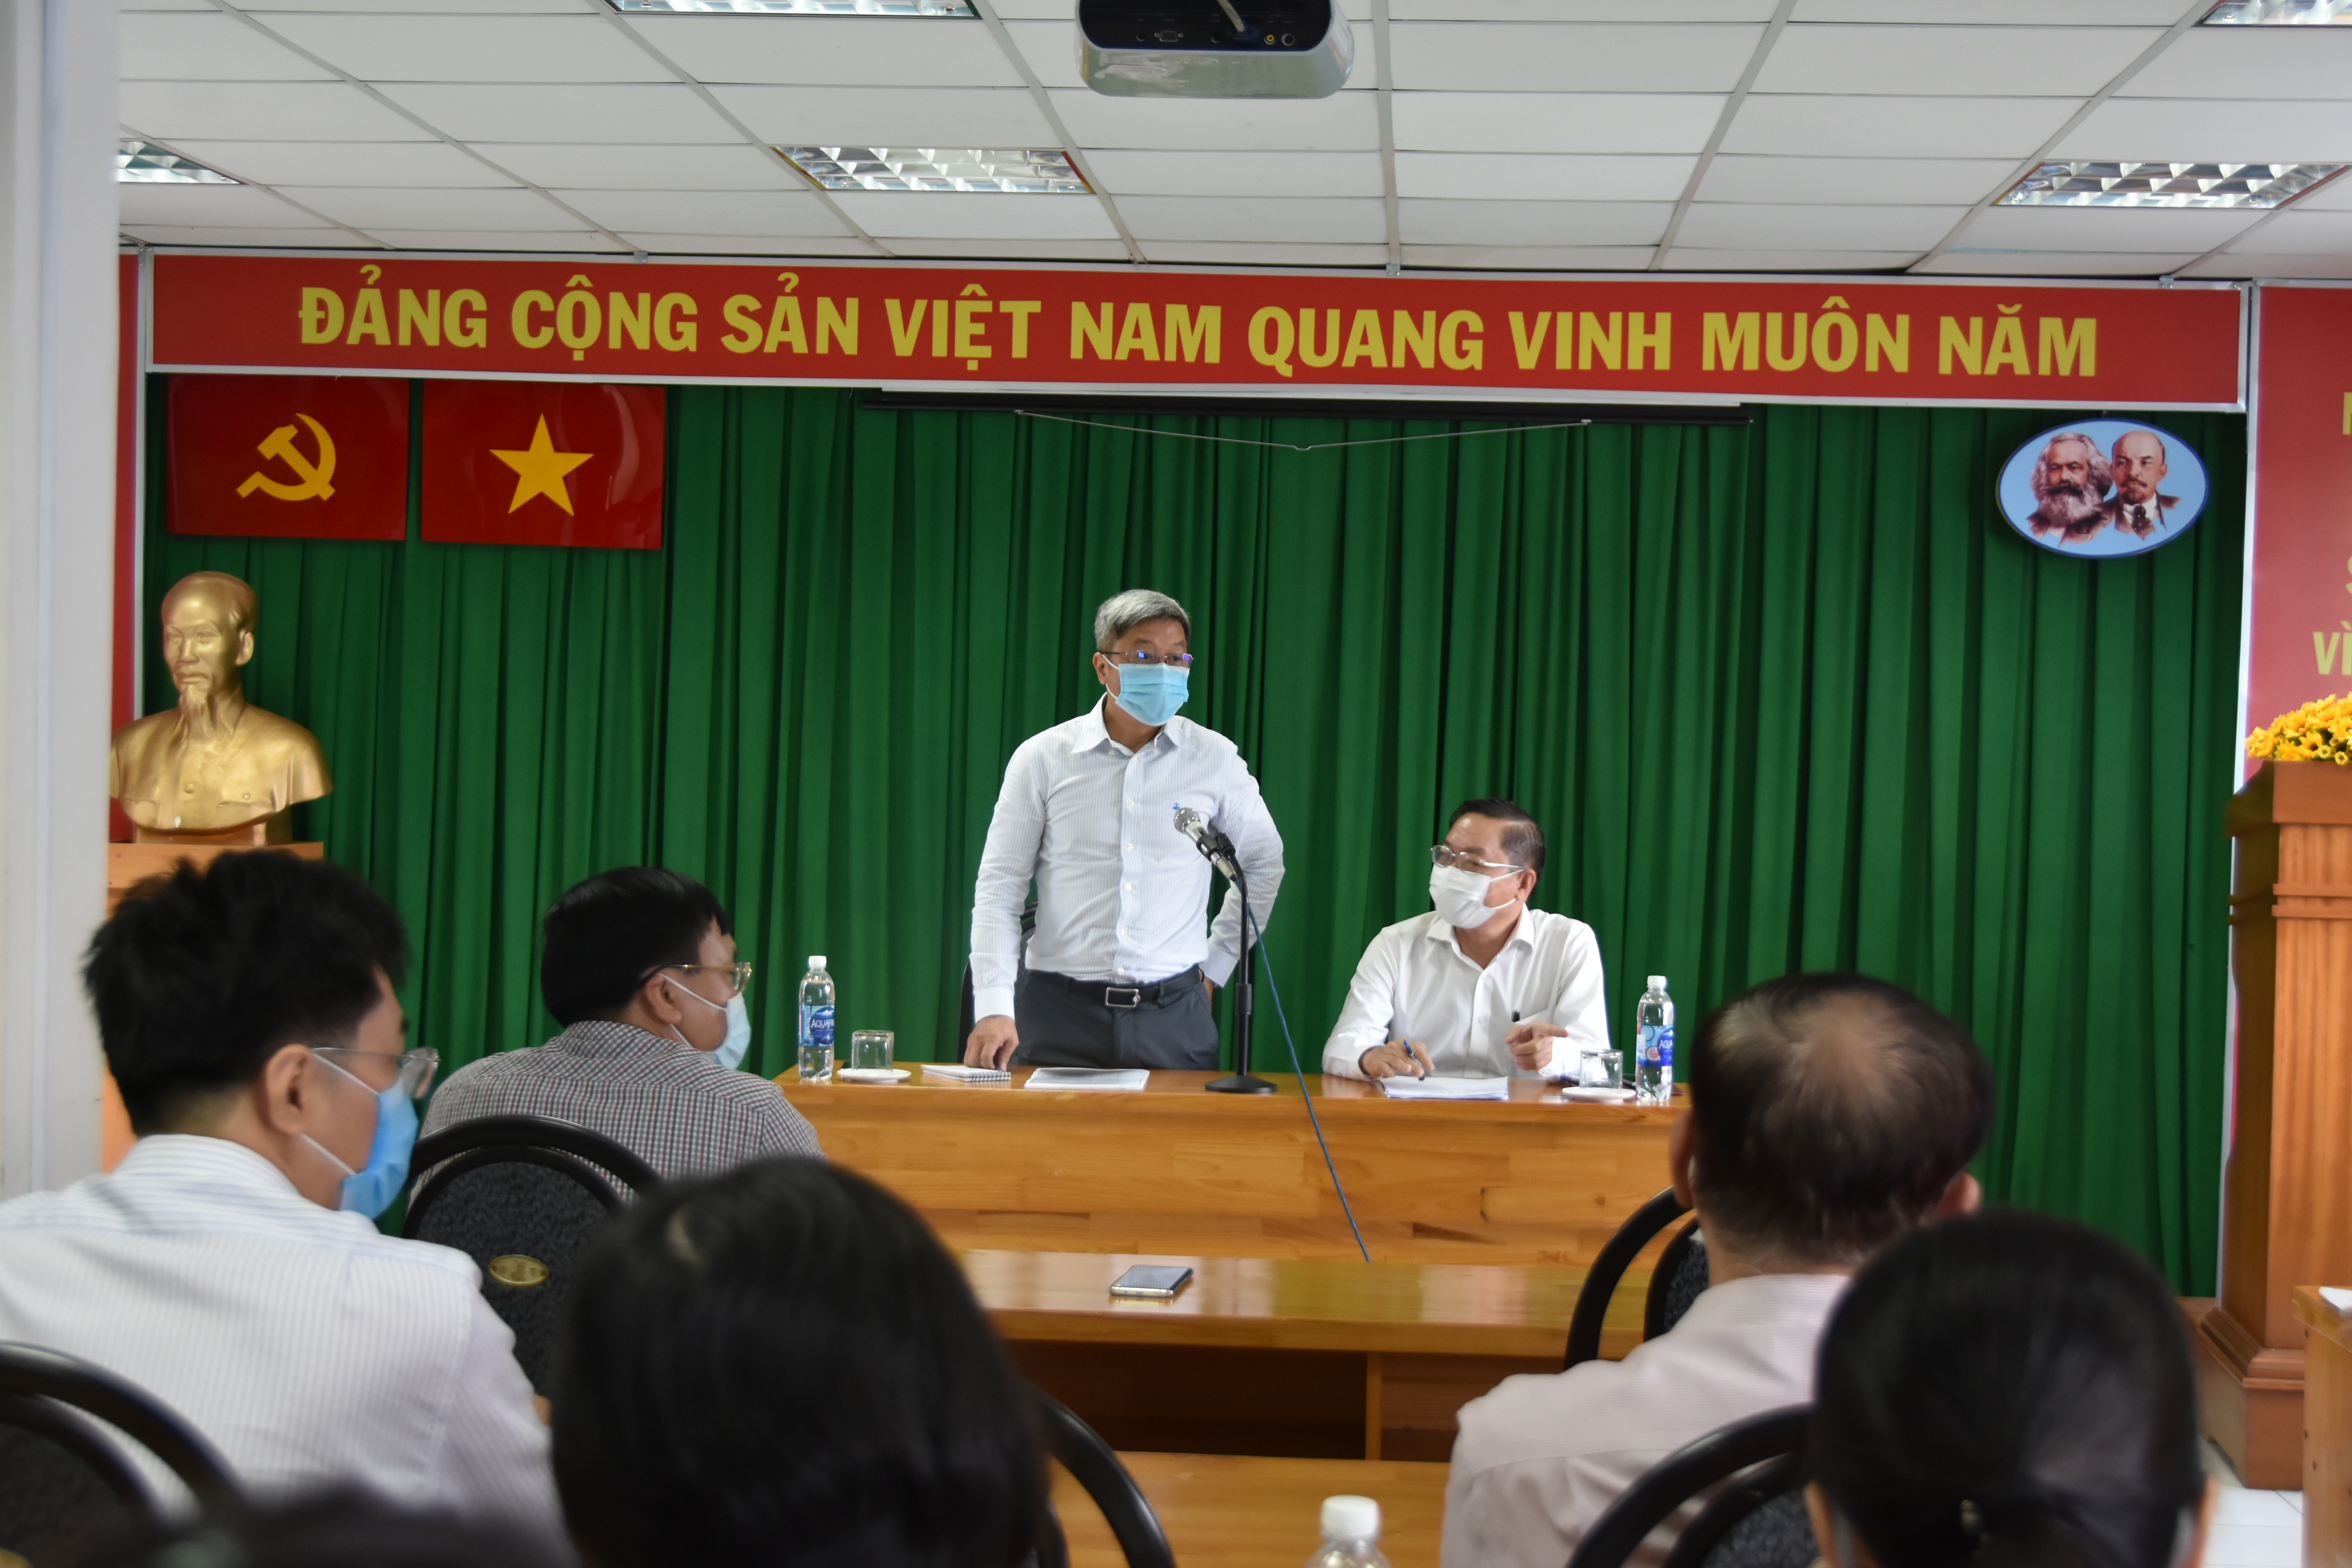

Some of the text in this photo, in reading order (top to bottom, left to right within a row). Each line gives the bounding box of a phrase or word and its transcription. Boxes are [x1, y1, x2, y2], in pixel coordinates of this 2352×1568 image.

[299, 265, 2096, 377] ĐẢNG CỘNG SẢN VIỆT NAM QUANG VINH MUÔN NĂM
